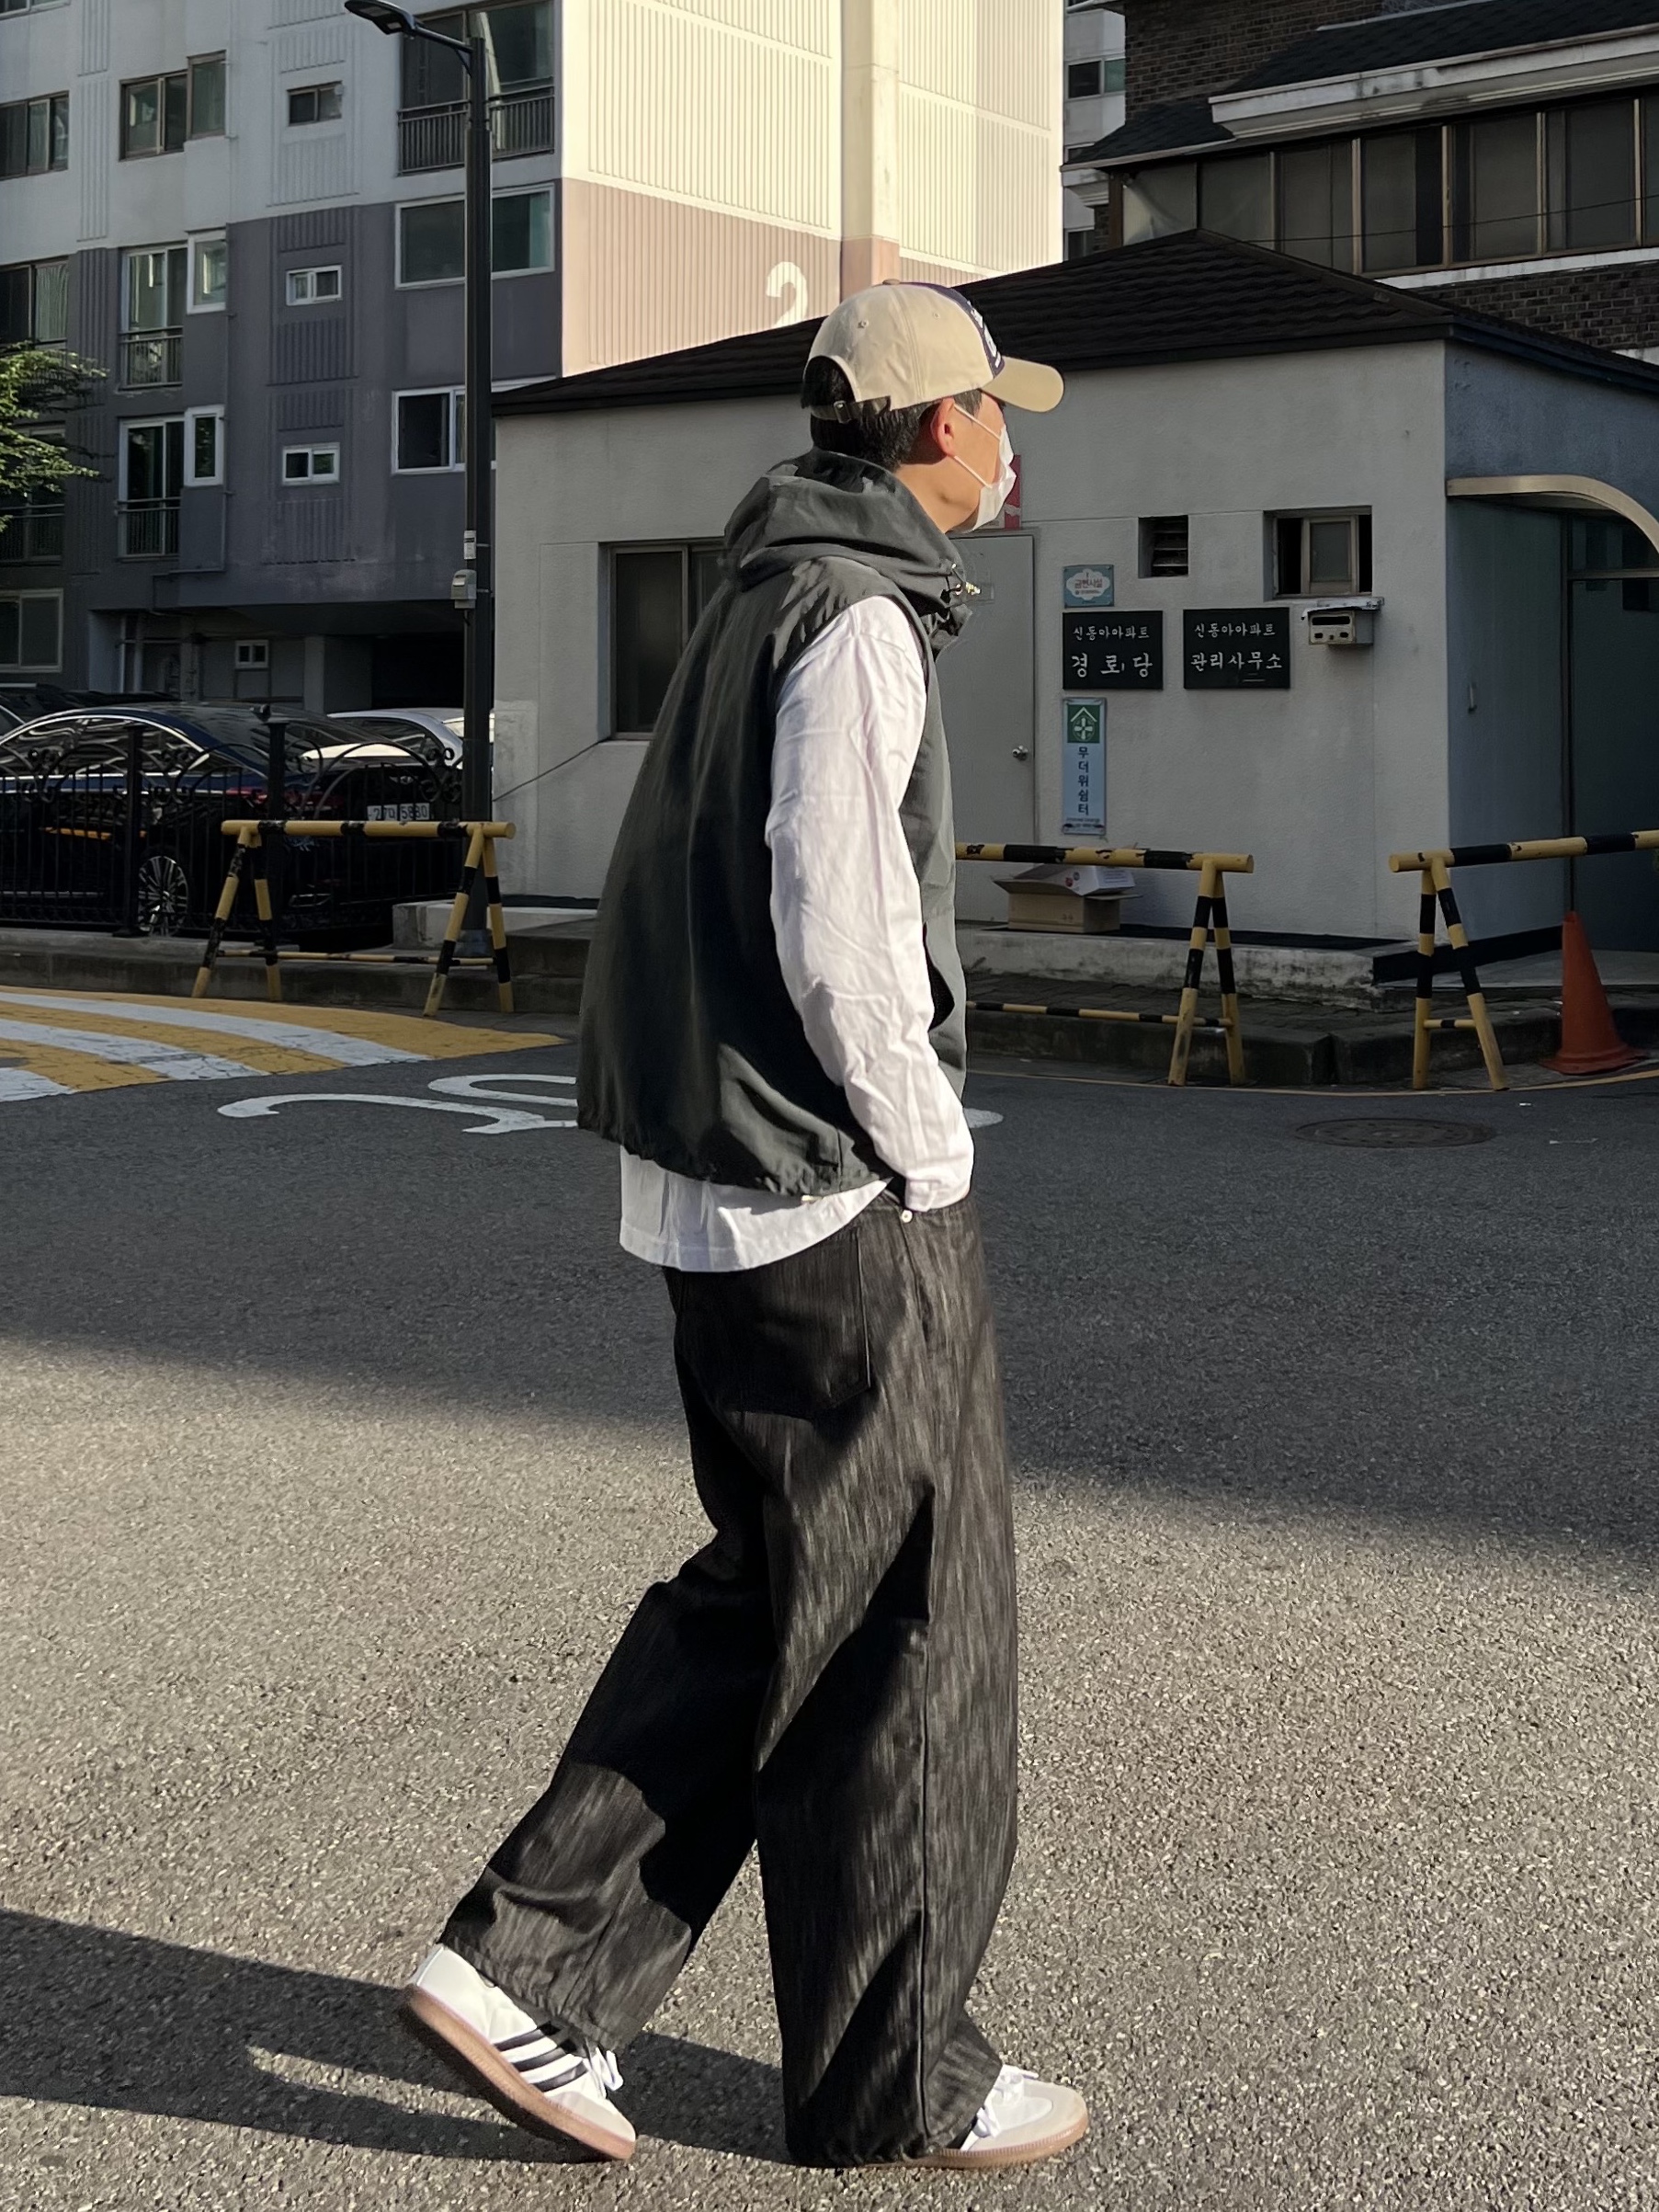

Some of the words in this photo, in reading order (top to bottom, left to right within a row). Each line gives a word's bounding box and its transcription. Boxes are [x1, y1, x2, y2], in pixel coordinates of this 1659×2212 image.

[1073, 626, 1149, 640] 신동아아파트
[1195, 622, 1276, 638] 신동아아파트
[1191, 652, 1282, 671] 관리사무소
